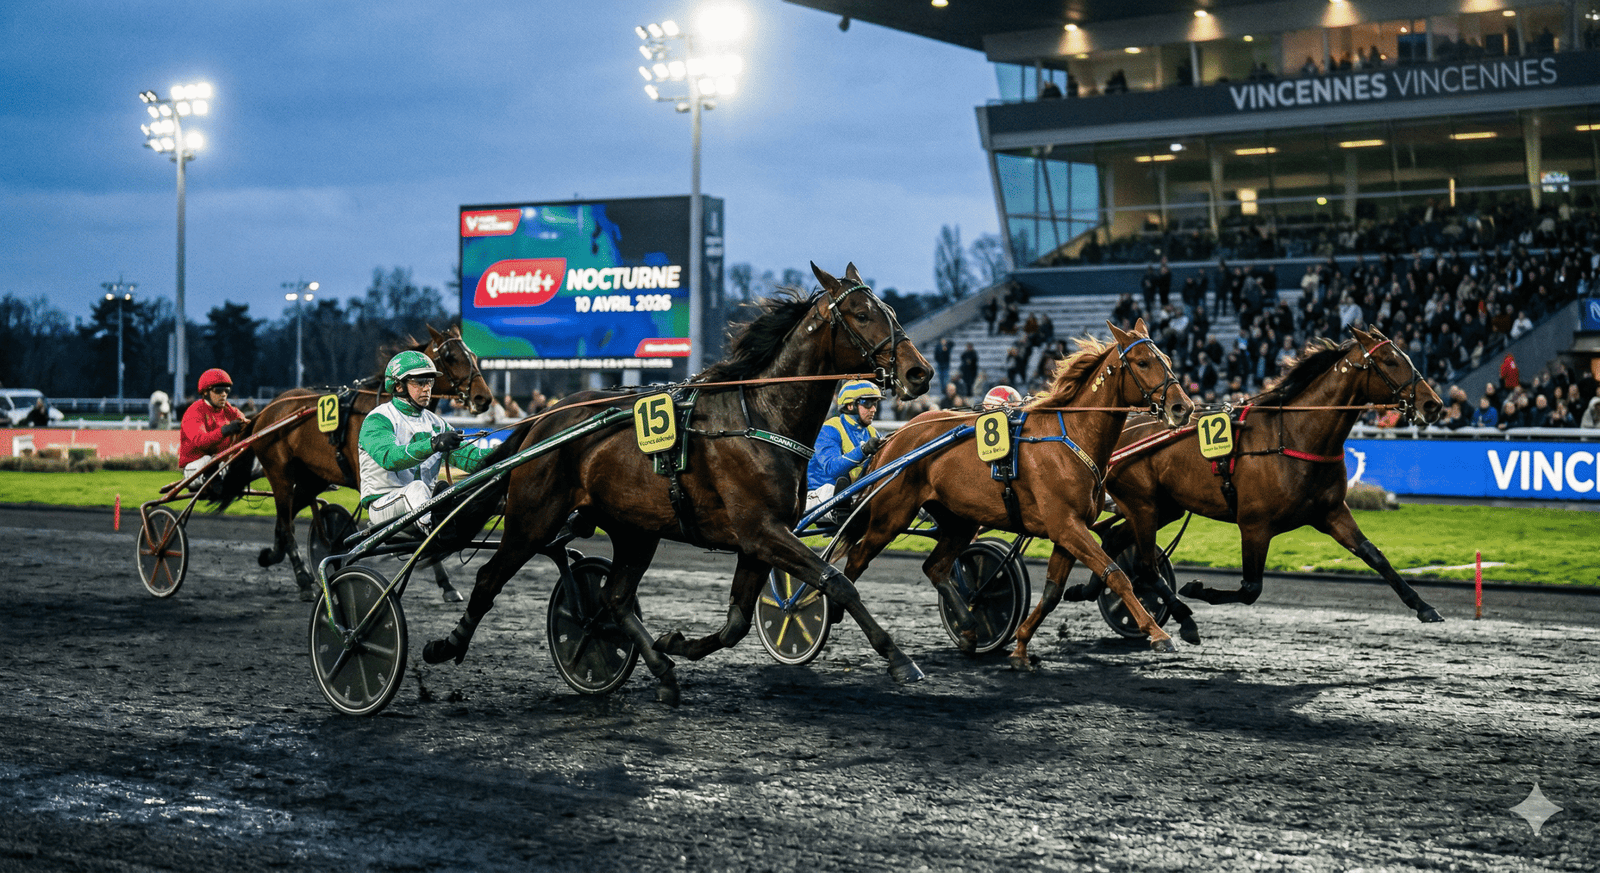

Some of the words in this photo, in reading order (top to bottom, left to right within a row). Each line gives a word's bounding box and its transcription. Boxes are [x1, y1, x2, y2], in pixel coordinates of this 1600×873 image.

[1230, 73, 1387, 110] VINCENNES
[1392, 58, 1557, 96] VINCENNES
[486, 269, 555, 298] Quinté+
[566, 265, 681, 291] NOCTURNE
[575, 296, 591, 313] 10
[591, 295, 634, 312] AVRIL
[635, 294, 672, 312] 2026
[320, 398, 336, 422] 12
[638, 398, 669, 437] 15
[984, 418, 1000, 446] 8
[1201, 417, 1228, 445] 12
[1487, 449, 1600, 493] VINC
